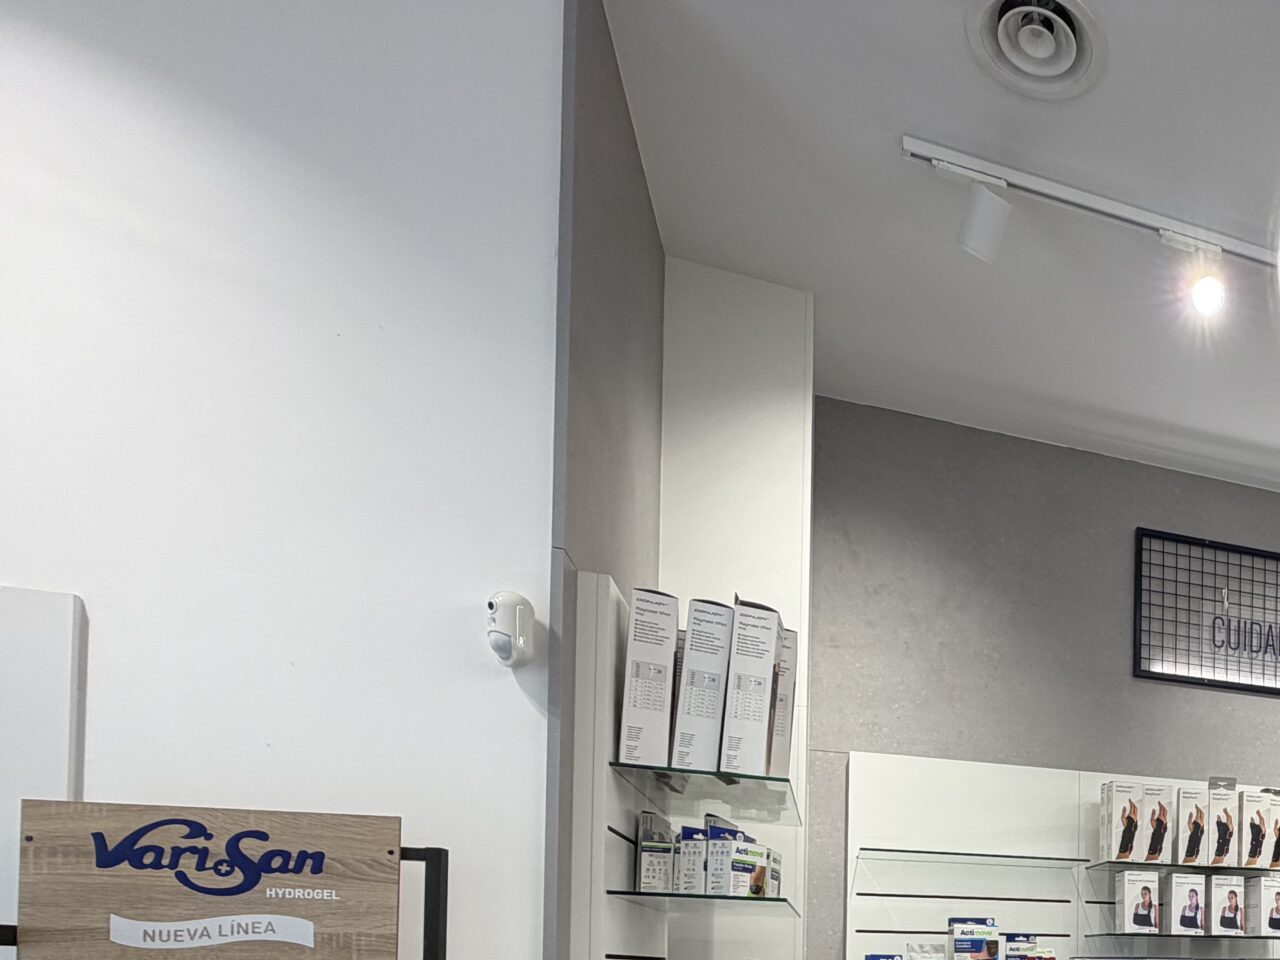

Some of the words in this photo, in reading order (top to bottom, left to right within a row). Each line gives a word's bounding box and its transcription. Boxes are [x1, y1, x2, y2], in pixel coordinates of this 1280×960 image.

[91, 818, 326, 897] VariSan
[266, 887, 340, 900] HYDROGEL
[142, 926, 212, 944] NUEVA
[218, 920, 276, 939] LÍNEA
